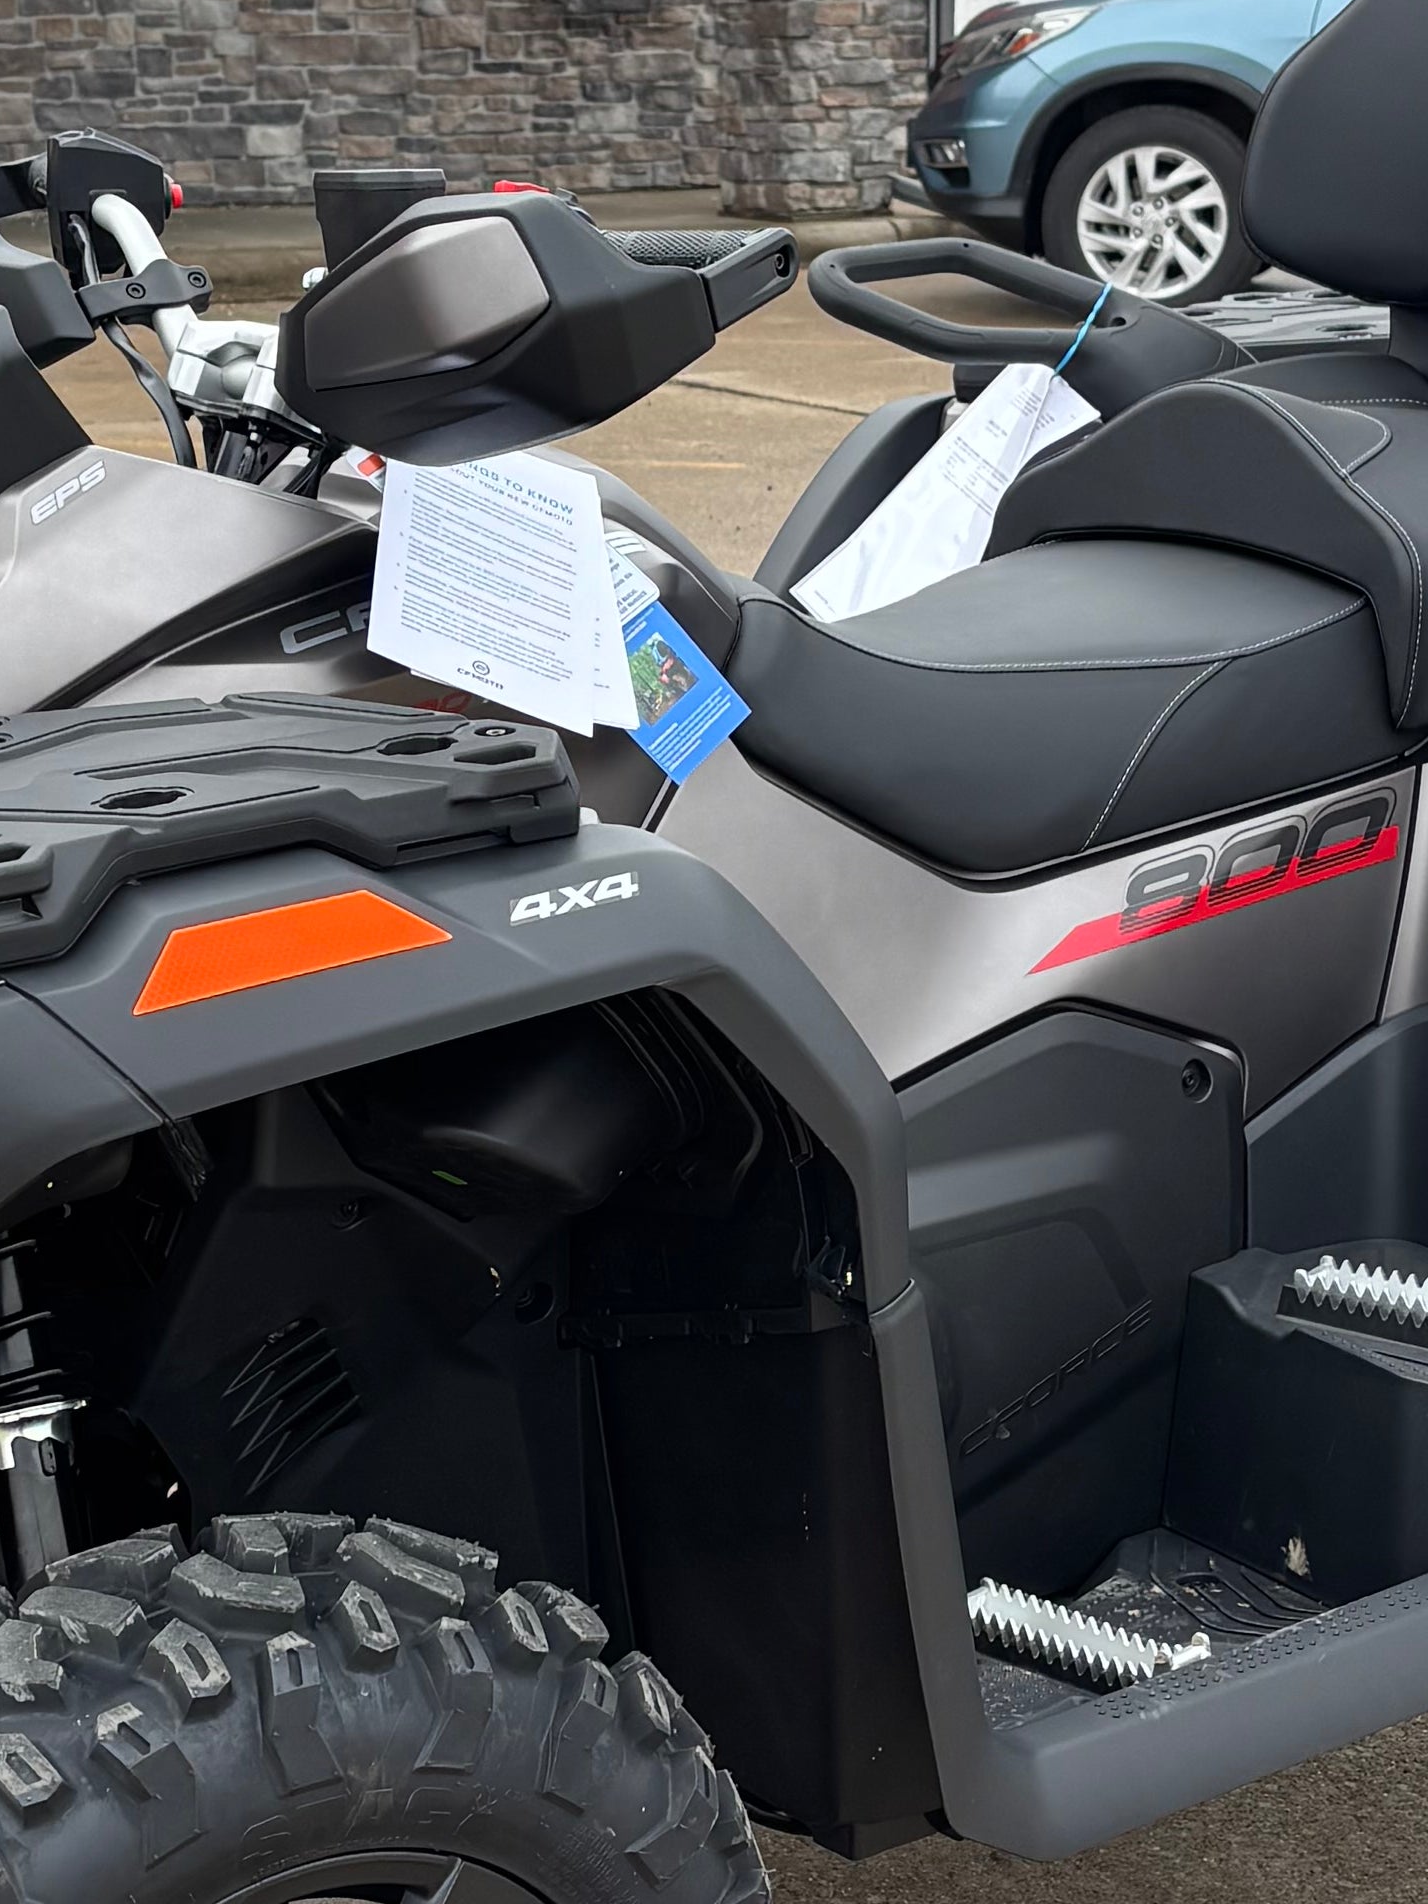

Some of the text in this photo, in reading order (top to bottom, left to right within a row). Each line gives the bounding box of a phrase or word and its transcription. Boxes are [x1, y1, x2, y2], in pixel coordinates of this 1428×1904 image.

[30, 460, 106, 525] EPS
[504, 477, 523, 492] TO
[527, 488, 573, 515] KNOW
[1119, 787, 1397, 934] 800
